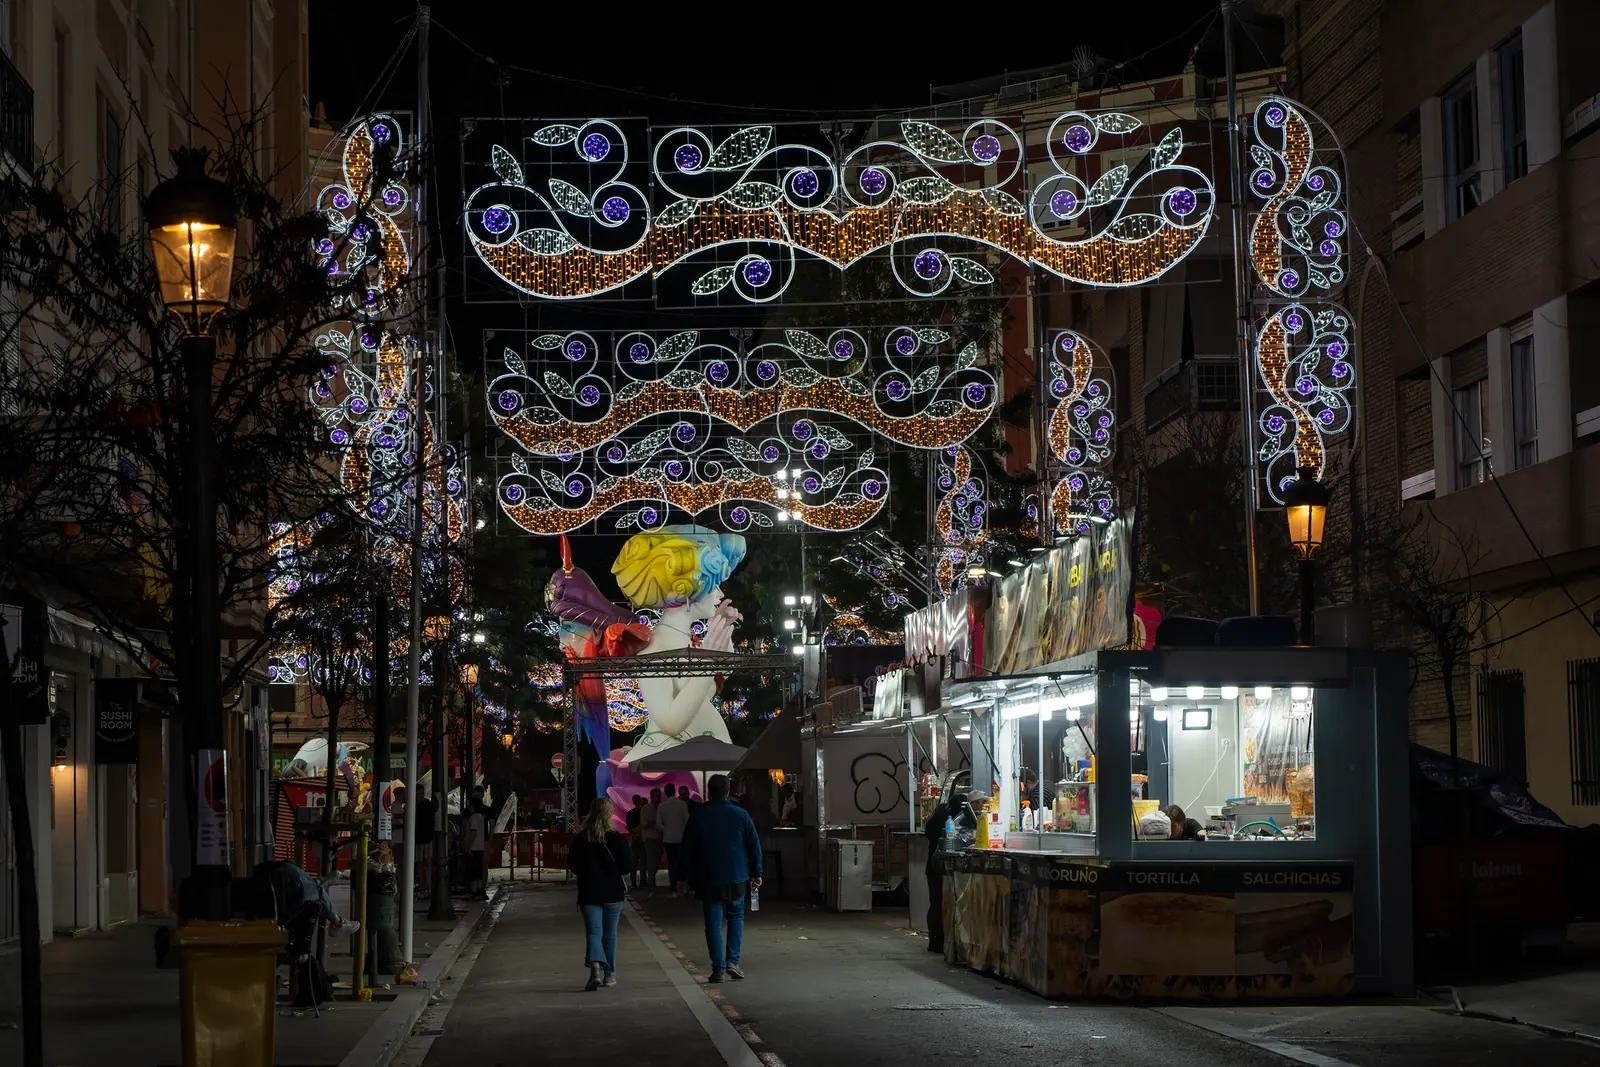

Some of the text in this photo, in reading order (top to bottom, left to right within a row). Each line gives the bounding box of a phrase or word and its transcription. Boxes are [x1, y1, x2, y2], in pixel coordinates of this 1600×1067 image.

[100, 711, 132, 720] SUSHI
[100, 720, 132, 729] ROOM
[1126, 871, 1200, 884] TORTILLA
[1242, 872, 1342, 885] SALCHICHAS
